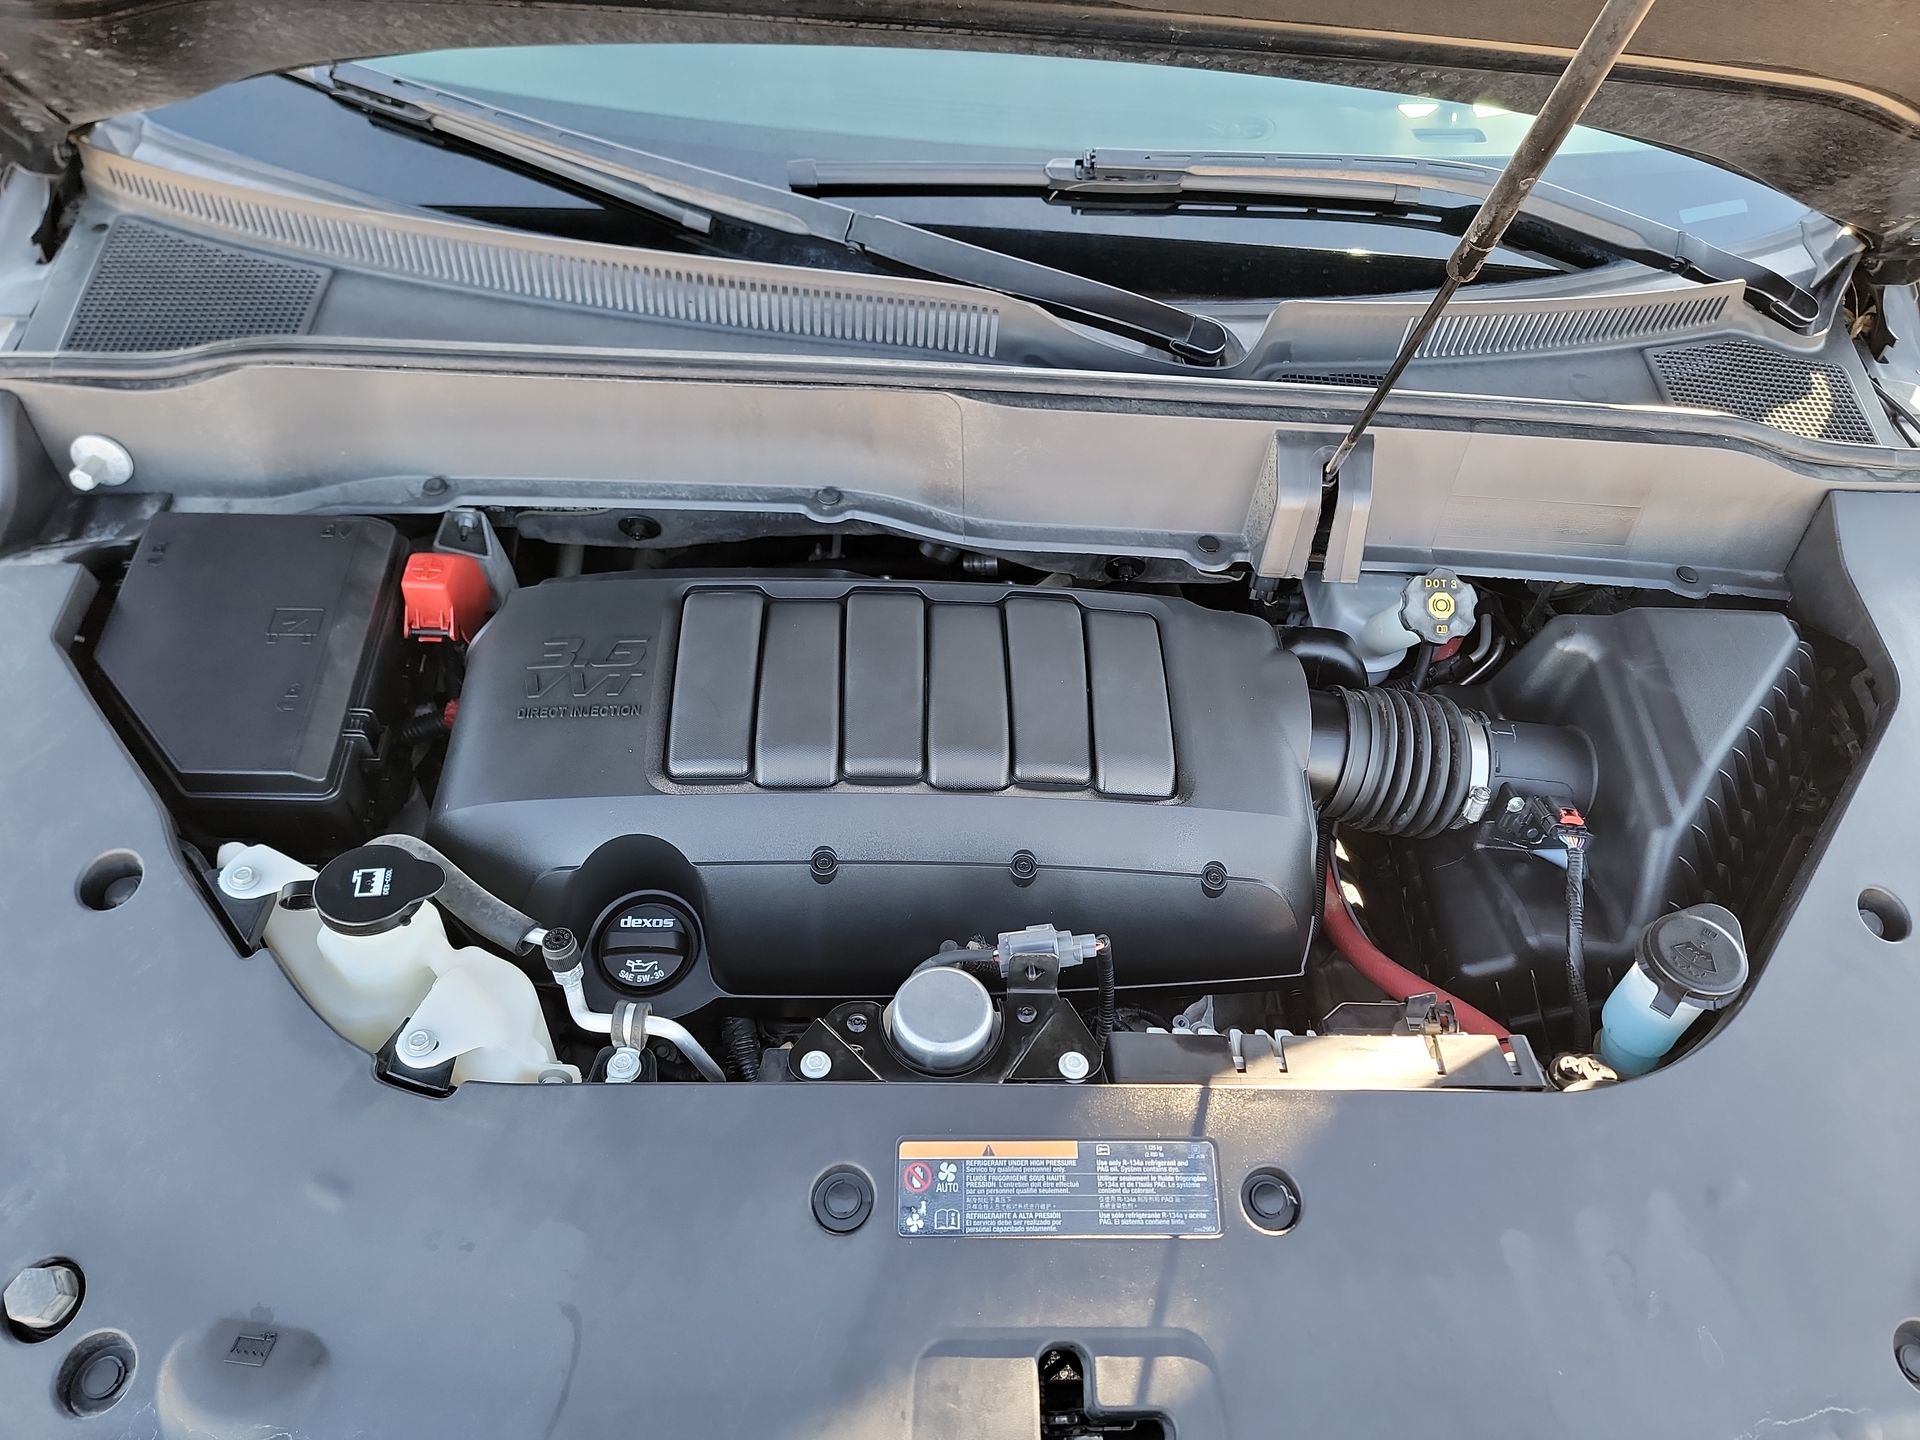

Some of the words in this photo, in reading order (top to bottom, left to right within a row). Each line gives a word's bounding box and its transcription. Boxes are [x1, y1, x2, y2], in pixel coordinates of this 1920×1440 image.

[1425, 579, 1447, 588] DOT
[1450, 579, 1457, 588] 3
[526, 637, 650, 670] 3.6
[524, 672, 644, 698] VVT
[517, 704, 568, 719] DIRECT
[569, 704, 641, 719] INJECTION
[620, 916, 676, 928] dexos
[618, 969, 635, 982] SAE
[636, 970, 665, 983] 5W-30
[936, 1183, 959, 1193] AUTO
